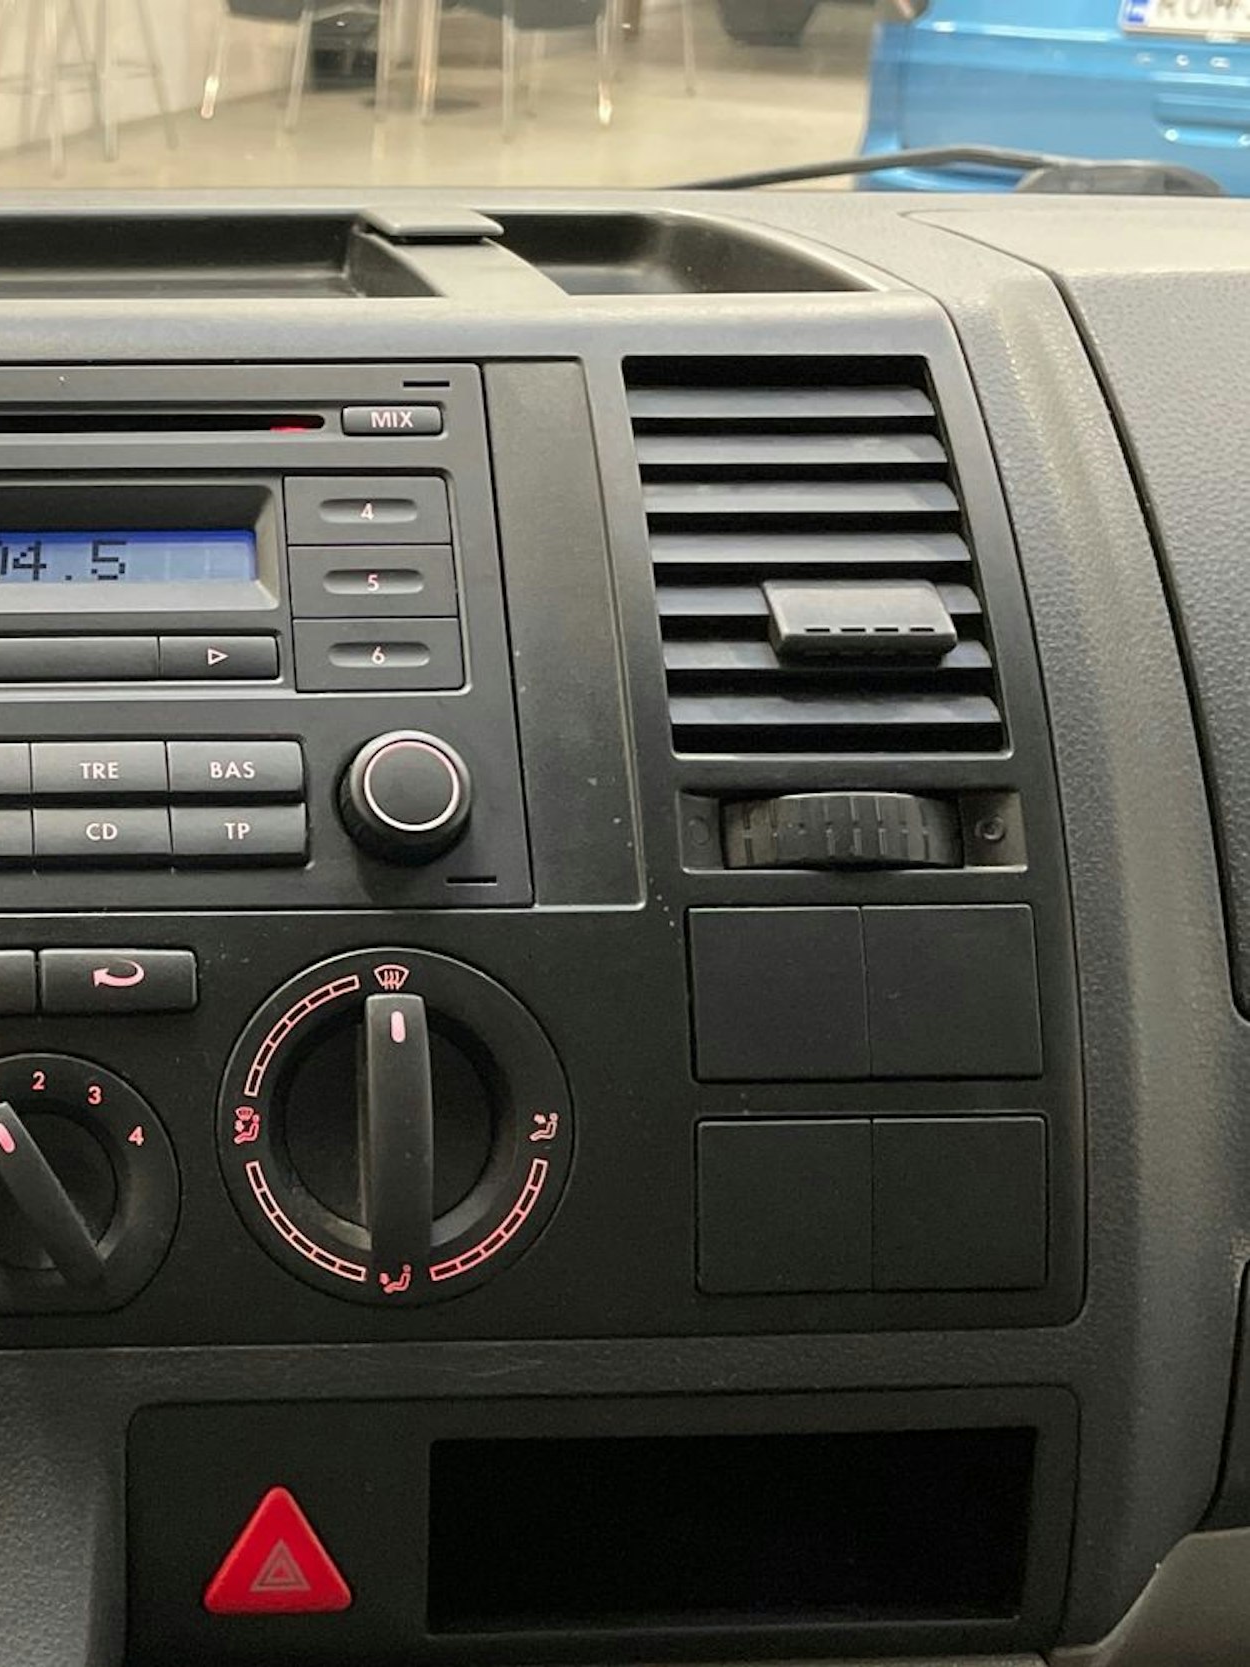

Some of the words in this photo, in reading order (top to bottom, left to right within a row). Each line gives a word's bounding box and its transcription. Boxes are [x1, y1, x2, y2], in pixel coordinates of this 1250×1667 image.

[370, 410, 415, 428] MIX
[360, 502, 375, 520] 4
[366, 574, 380, 593] 5
[371, 645, 385, 665] 6
[78, 761, 120, 781] TRE
[209, 760, 256, 780] BAS
[84, 822, 119, 841] CD
[223, 821, 252, 841] TP
[32, 1071, 46, 1091] 2
[87, 1086, 102, 1105] 3
[127, 1125, 145, 1146] 4
